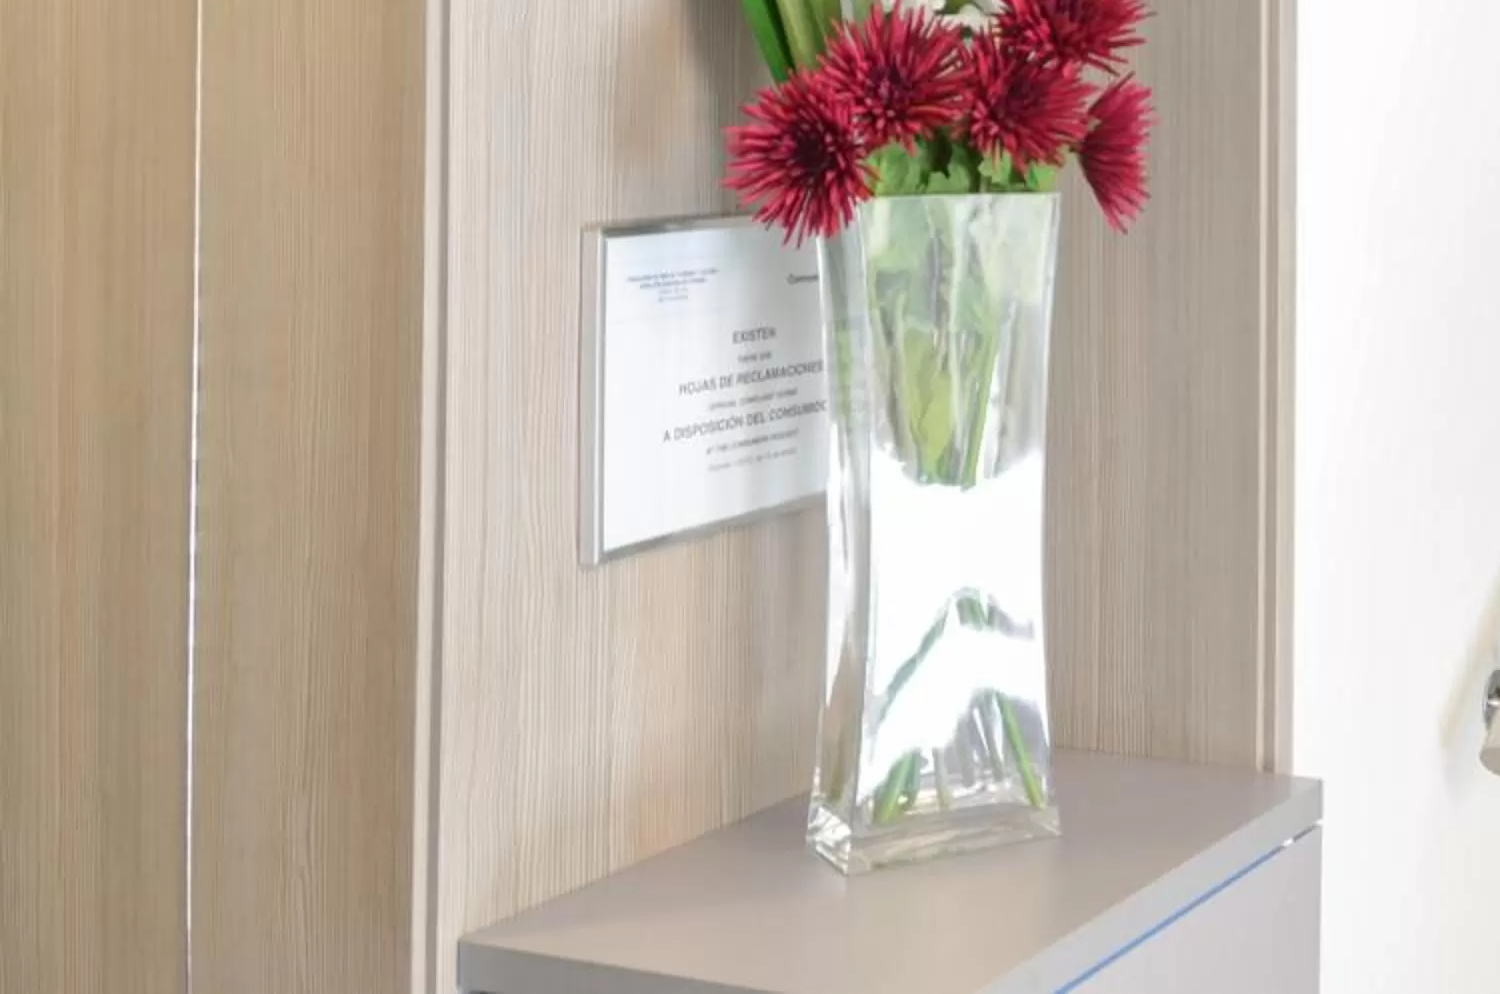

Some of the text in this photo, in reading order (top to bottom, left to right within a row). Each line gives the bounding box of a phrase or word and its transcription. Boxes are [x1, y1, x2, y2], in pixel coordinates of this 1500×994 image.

[678, 375, 717, 396] HOJAS
[719, 373, 733, 390] DE
[746, 411, 766, 427] DEL
